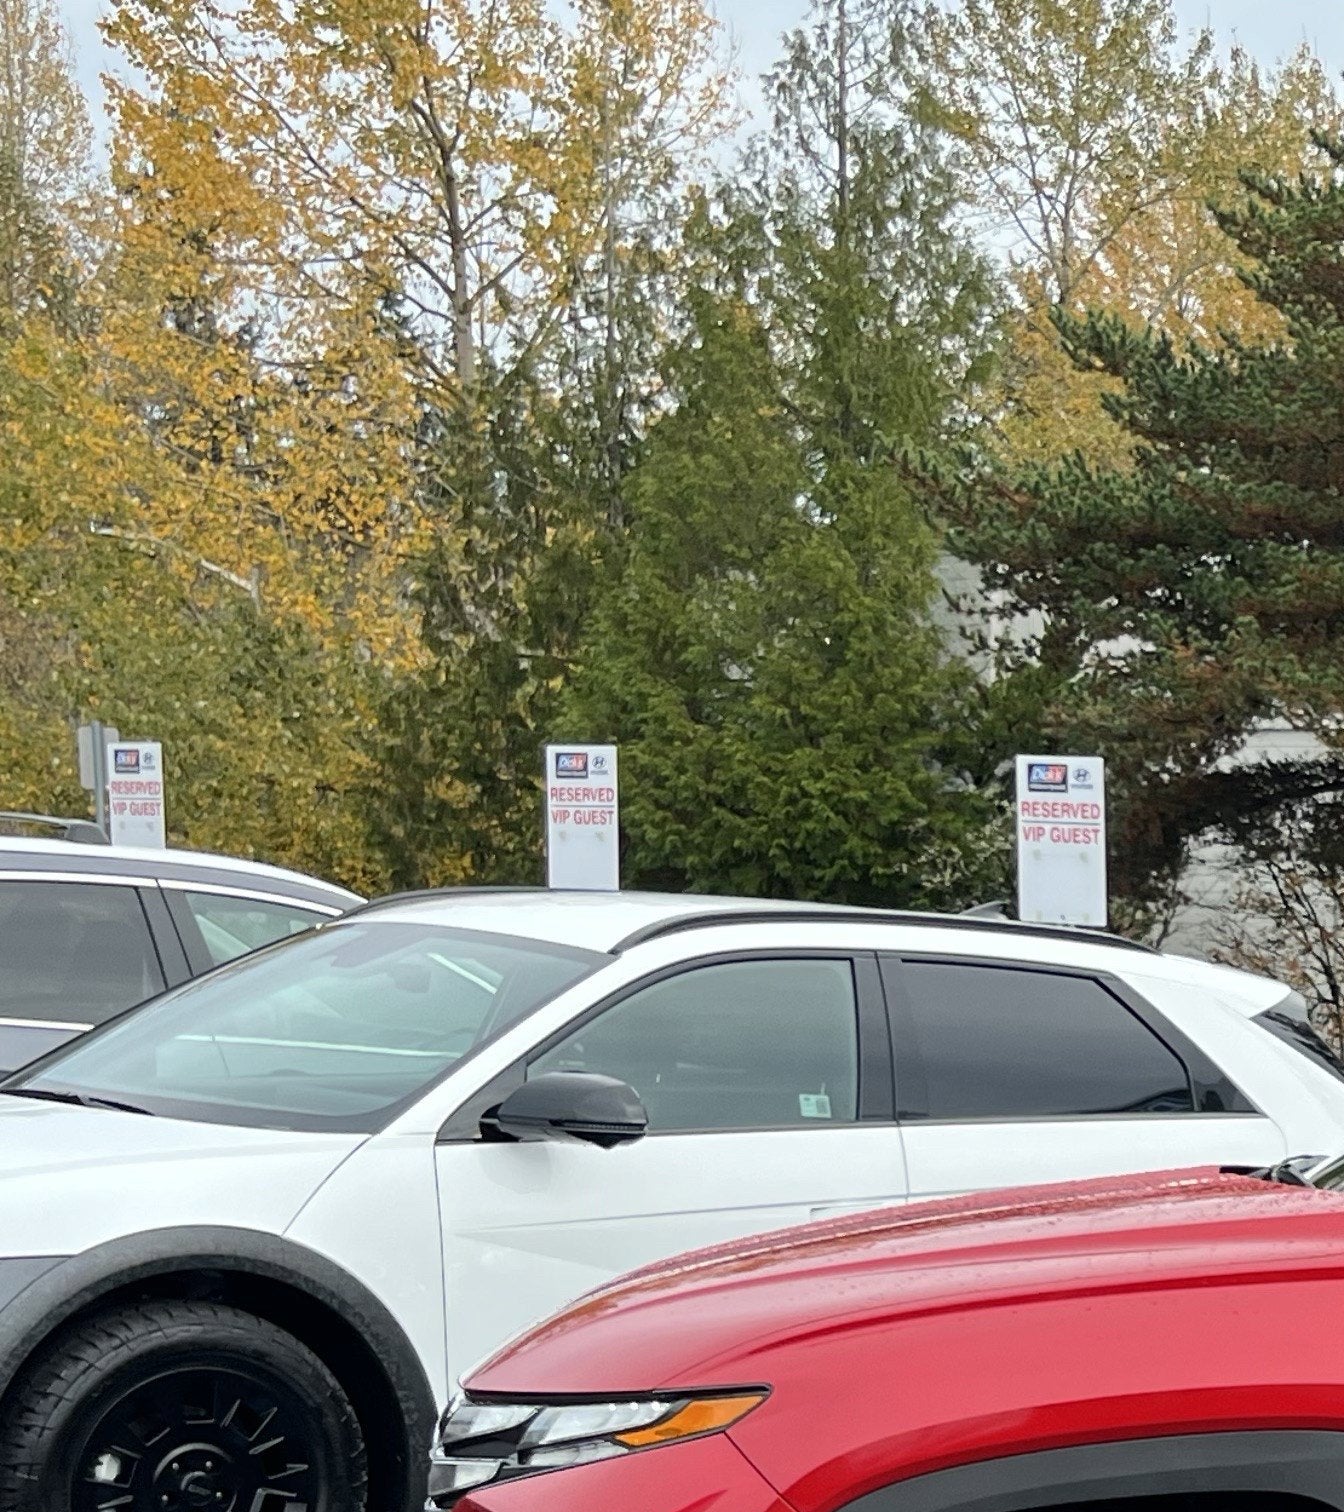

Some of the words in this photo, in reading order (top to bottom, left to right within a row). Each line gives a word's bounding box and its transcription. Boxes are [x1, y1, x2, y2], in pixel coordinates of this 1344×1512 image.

[110, 781, 162, 796] RESERVED
[550, 787, 615, 802] RESERVED
[130, 802, 162, 817] GUEST
[551, 809, 570, 824] VIP
[573, 809, 615, 825] GUEST
[1021, 801, 1100, 820] RESERVED
[1022, 826, 1046, 843] VIP
[1050, 827, 1100, 845] GUEST
